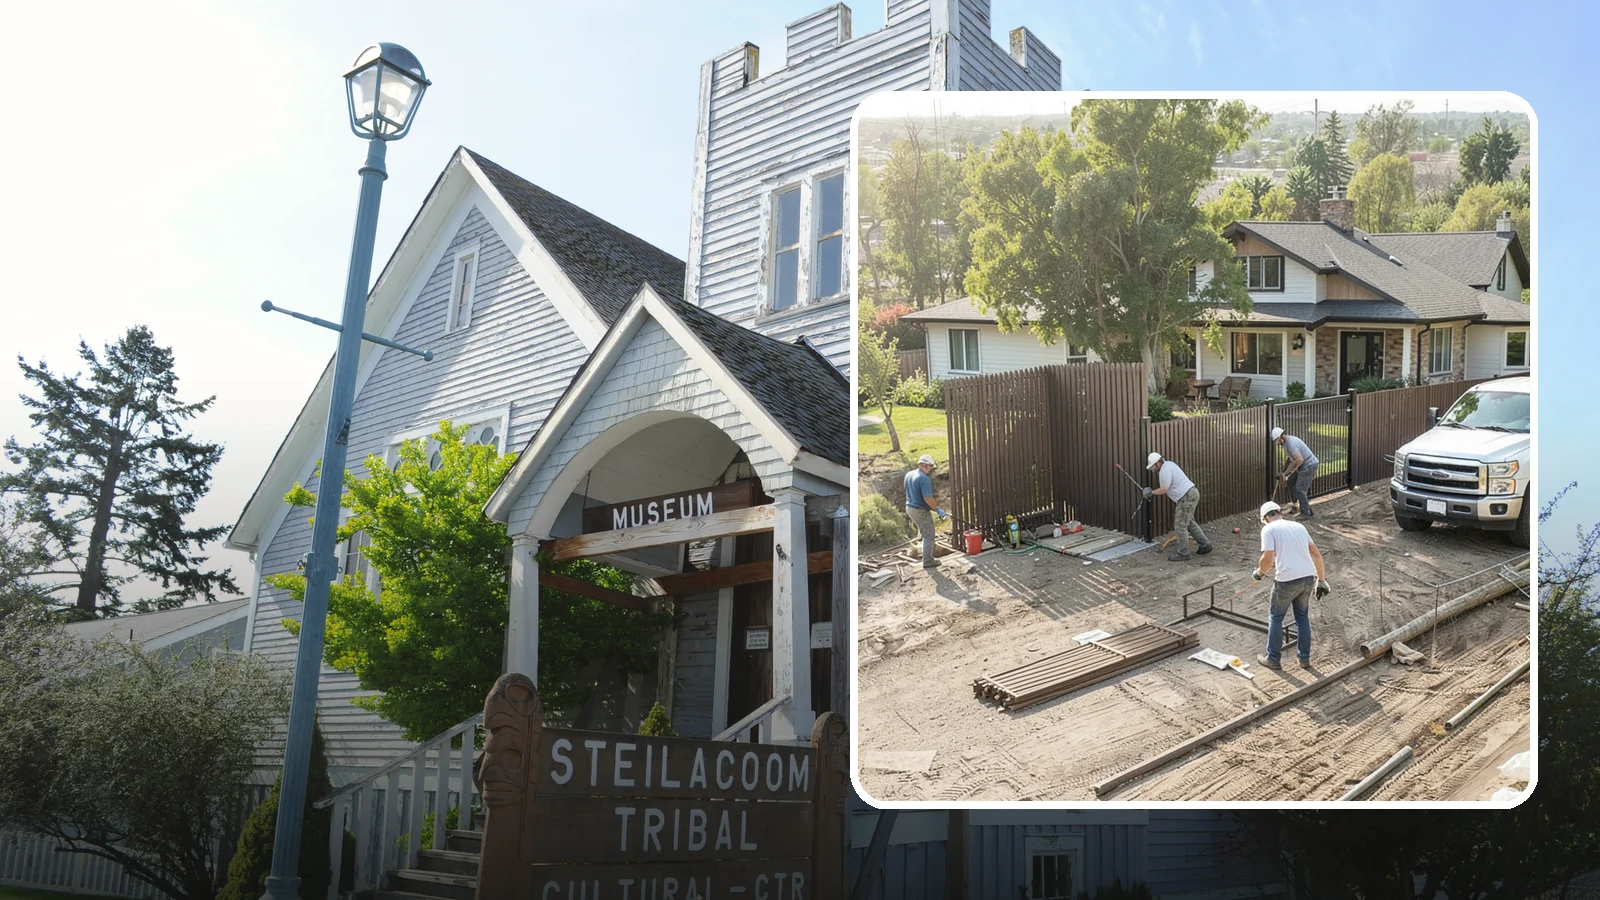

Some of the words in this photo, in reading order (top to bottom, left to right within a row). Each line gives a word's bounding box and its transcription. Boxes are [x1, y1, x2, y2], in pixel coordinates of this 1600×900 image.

[612, 491, 714, 531] MUSEUM
[550, 738, 810, 793] STEILACOOM
[614, 806, 758, 851] TRIBAL
